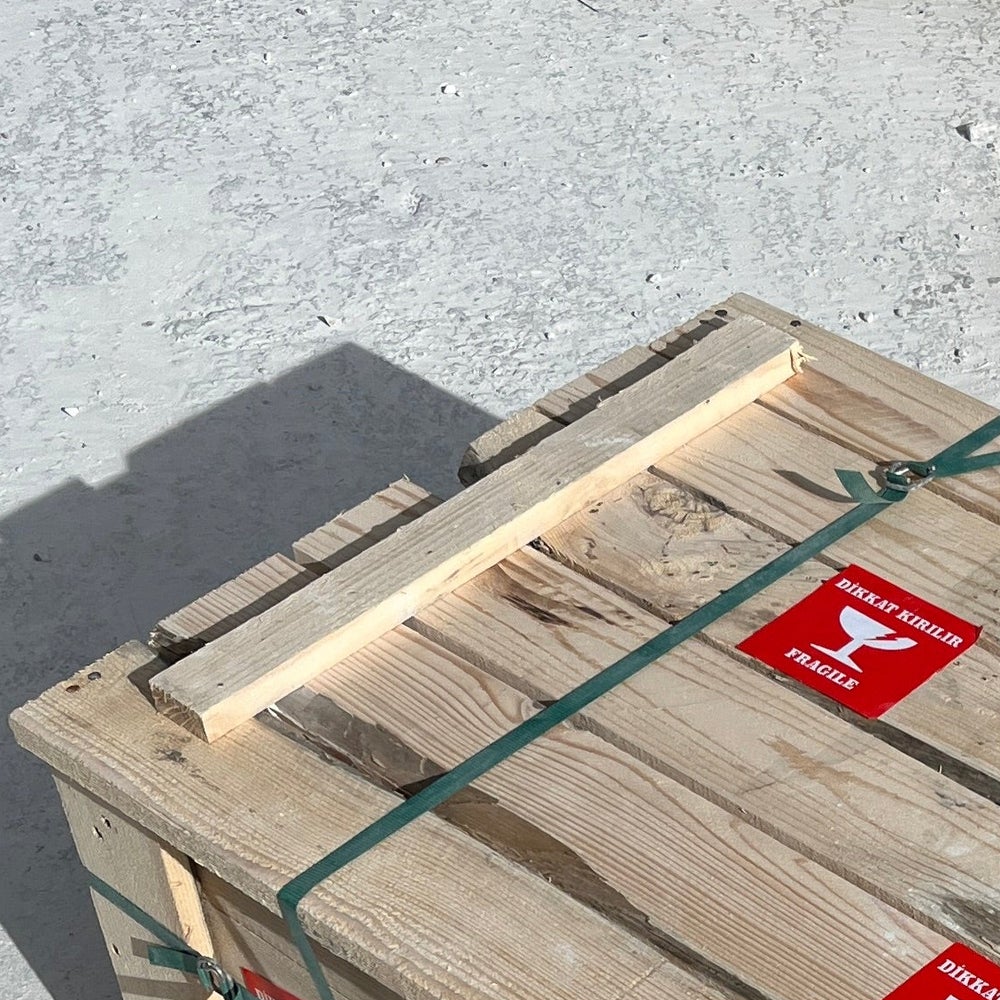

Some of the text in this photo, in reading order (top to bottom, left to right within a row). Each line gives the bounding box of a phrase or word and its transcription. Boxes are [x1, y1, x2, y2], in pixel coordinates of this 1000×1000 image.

[835, 578, 964, 649] DİKKAT KIRILIR
[784, 648, 859, 690] FRAGILE
